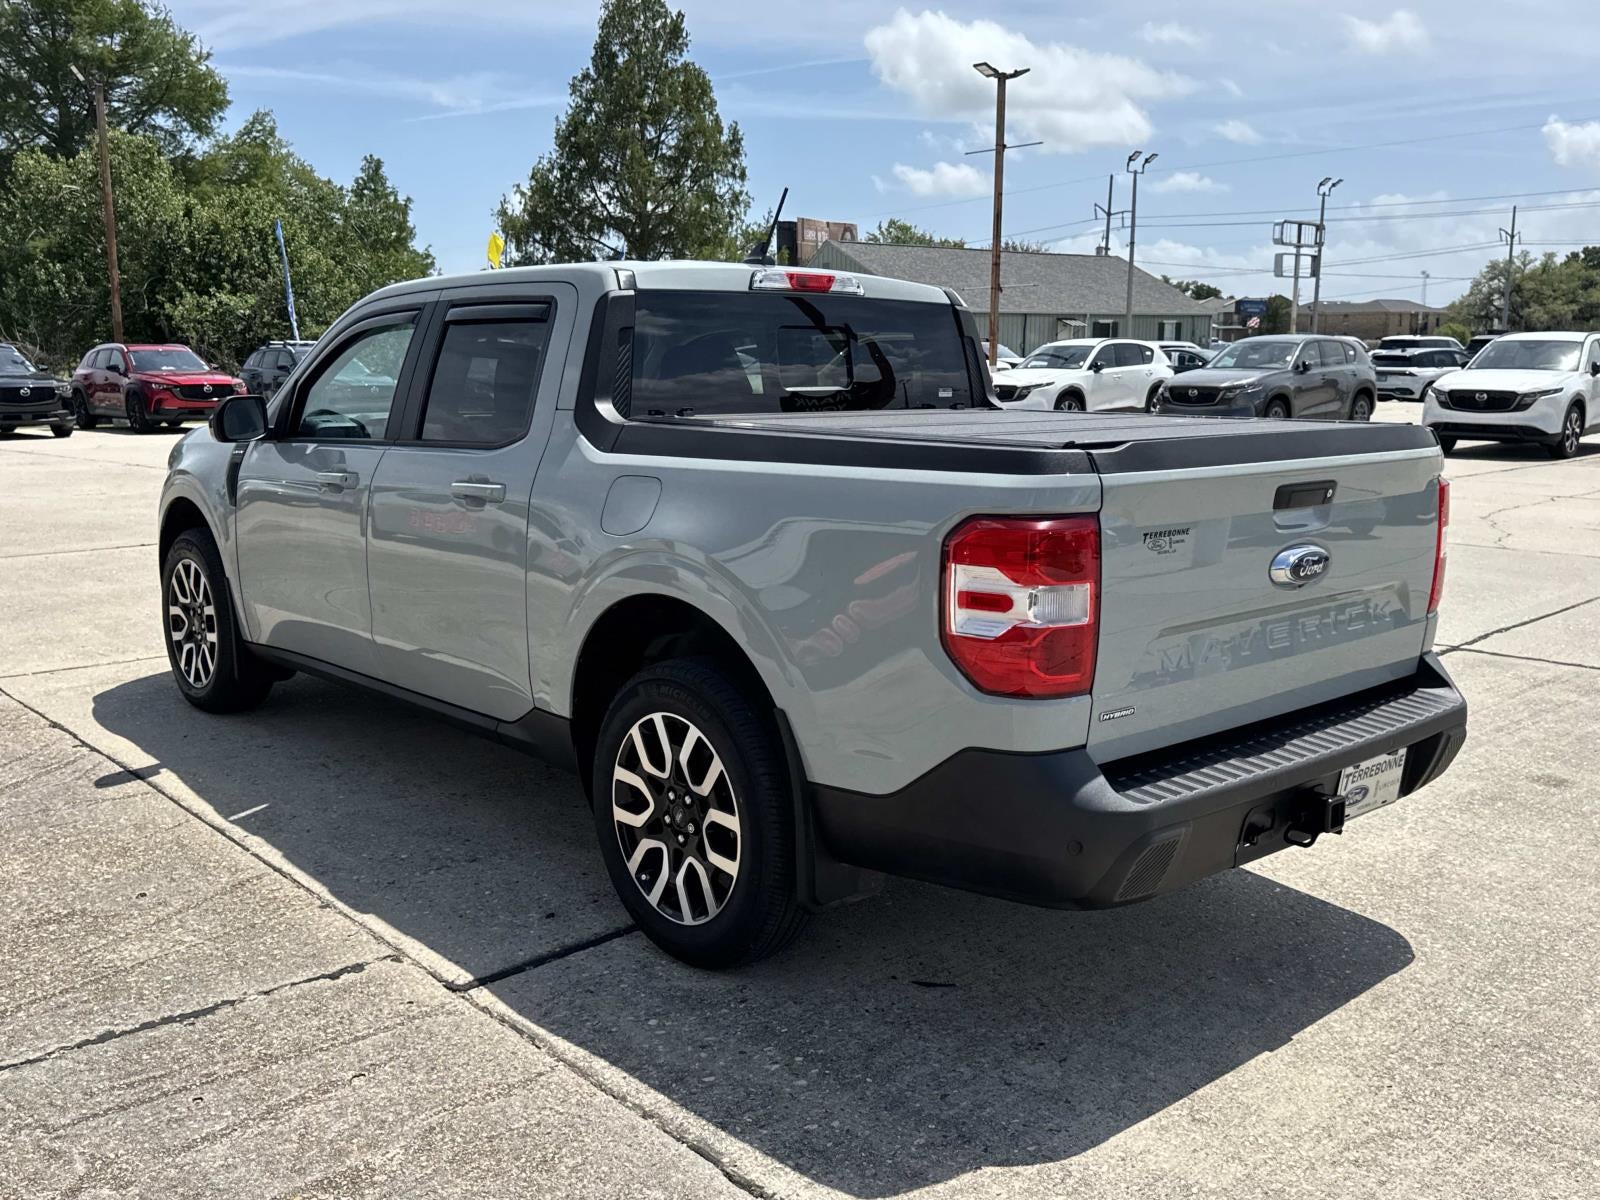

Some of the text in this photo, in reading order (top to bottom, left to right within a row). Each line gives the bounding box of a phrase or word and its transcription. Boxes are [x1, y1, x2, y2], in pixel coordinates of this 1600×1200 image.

[1143, 528, 1190, 544] TERREBONNE
[1299, 556, 1324, 577] Ford
[1160, 598, 1393, 670] MAVERICK
[1102, 707, 1135, 721] HYBRID
[1343, 754, 1405, 792] TERREBONNE
